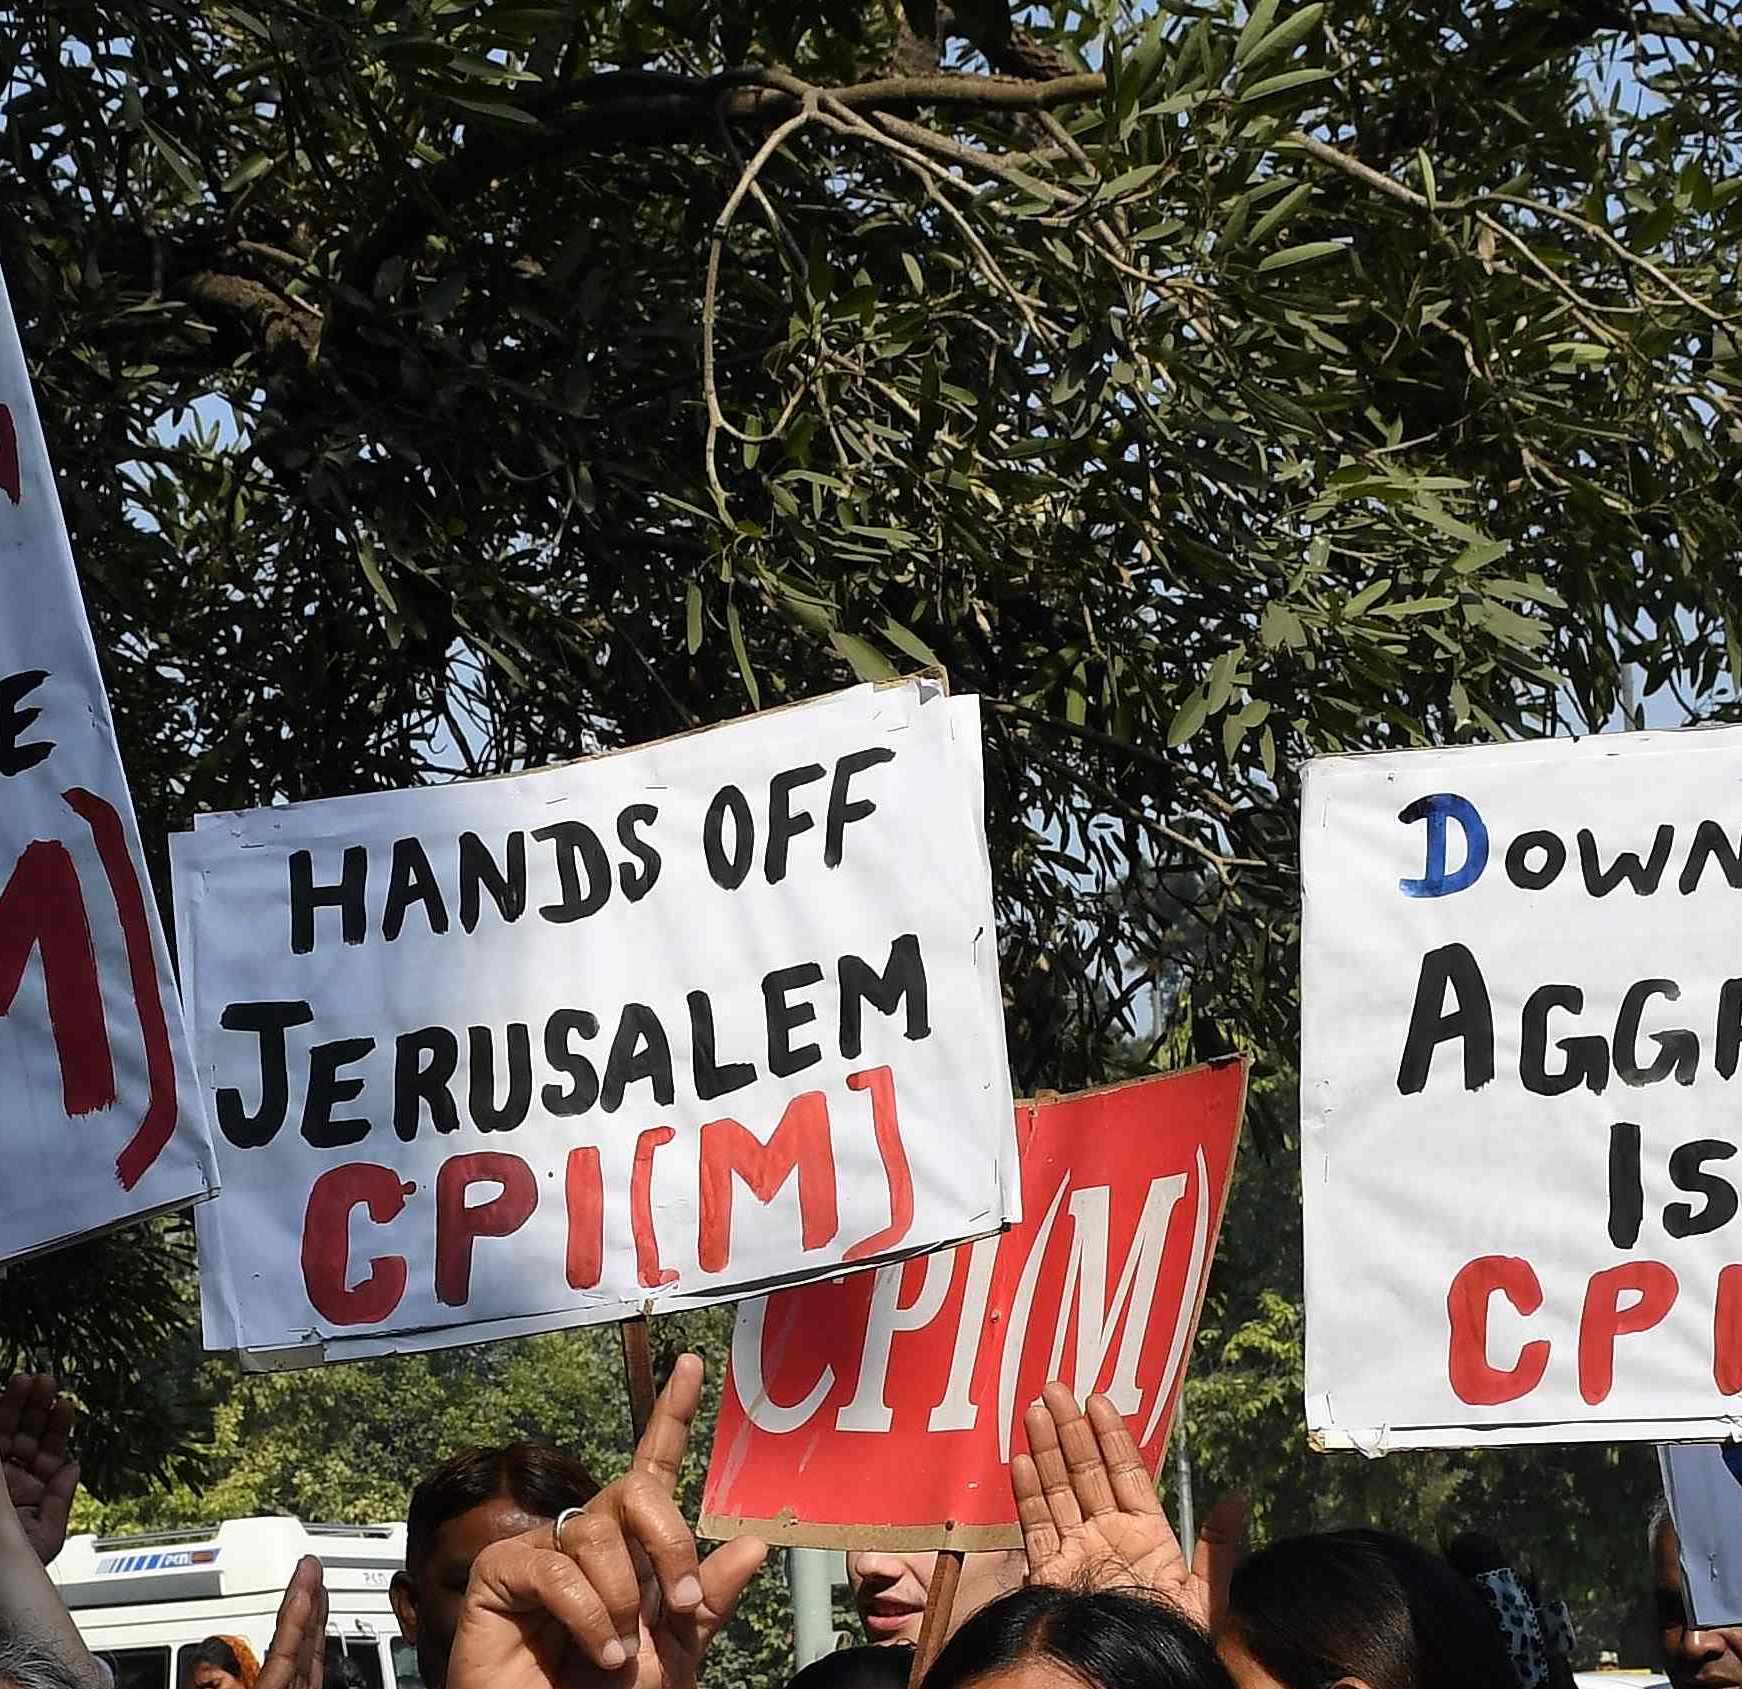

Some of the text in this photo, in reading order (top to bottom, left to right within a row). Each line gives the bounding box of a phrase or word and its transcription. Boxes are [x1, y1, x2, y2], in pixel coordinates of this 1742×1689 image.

[289, 746, 895, 955] HANDS OFF
[216, 933, 931, 1149] JERUSALEM
